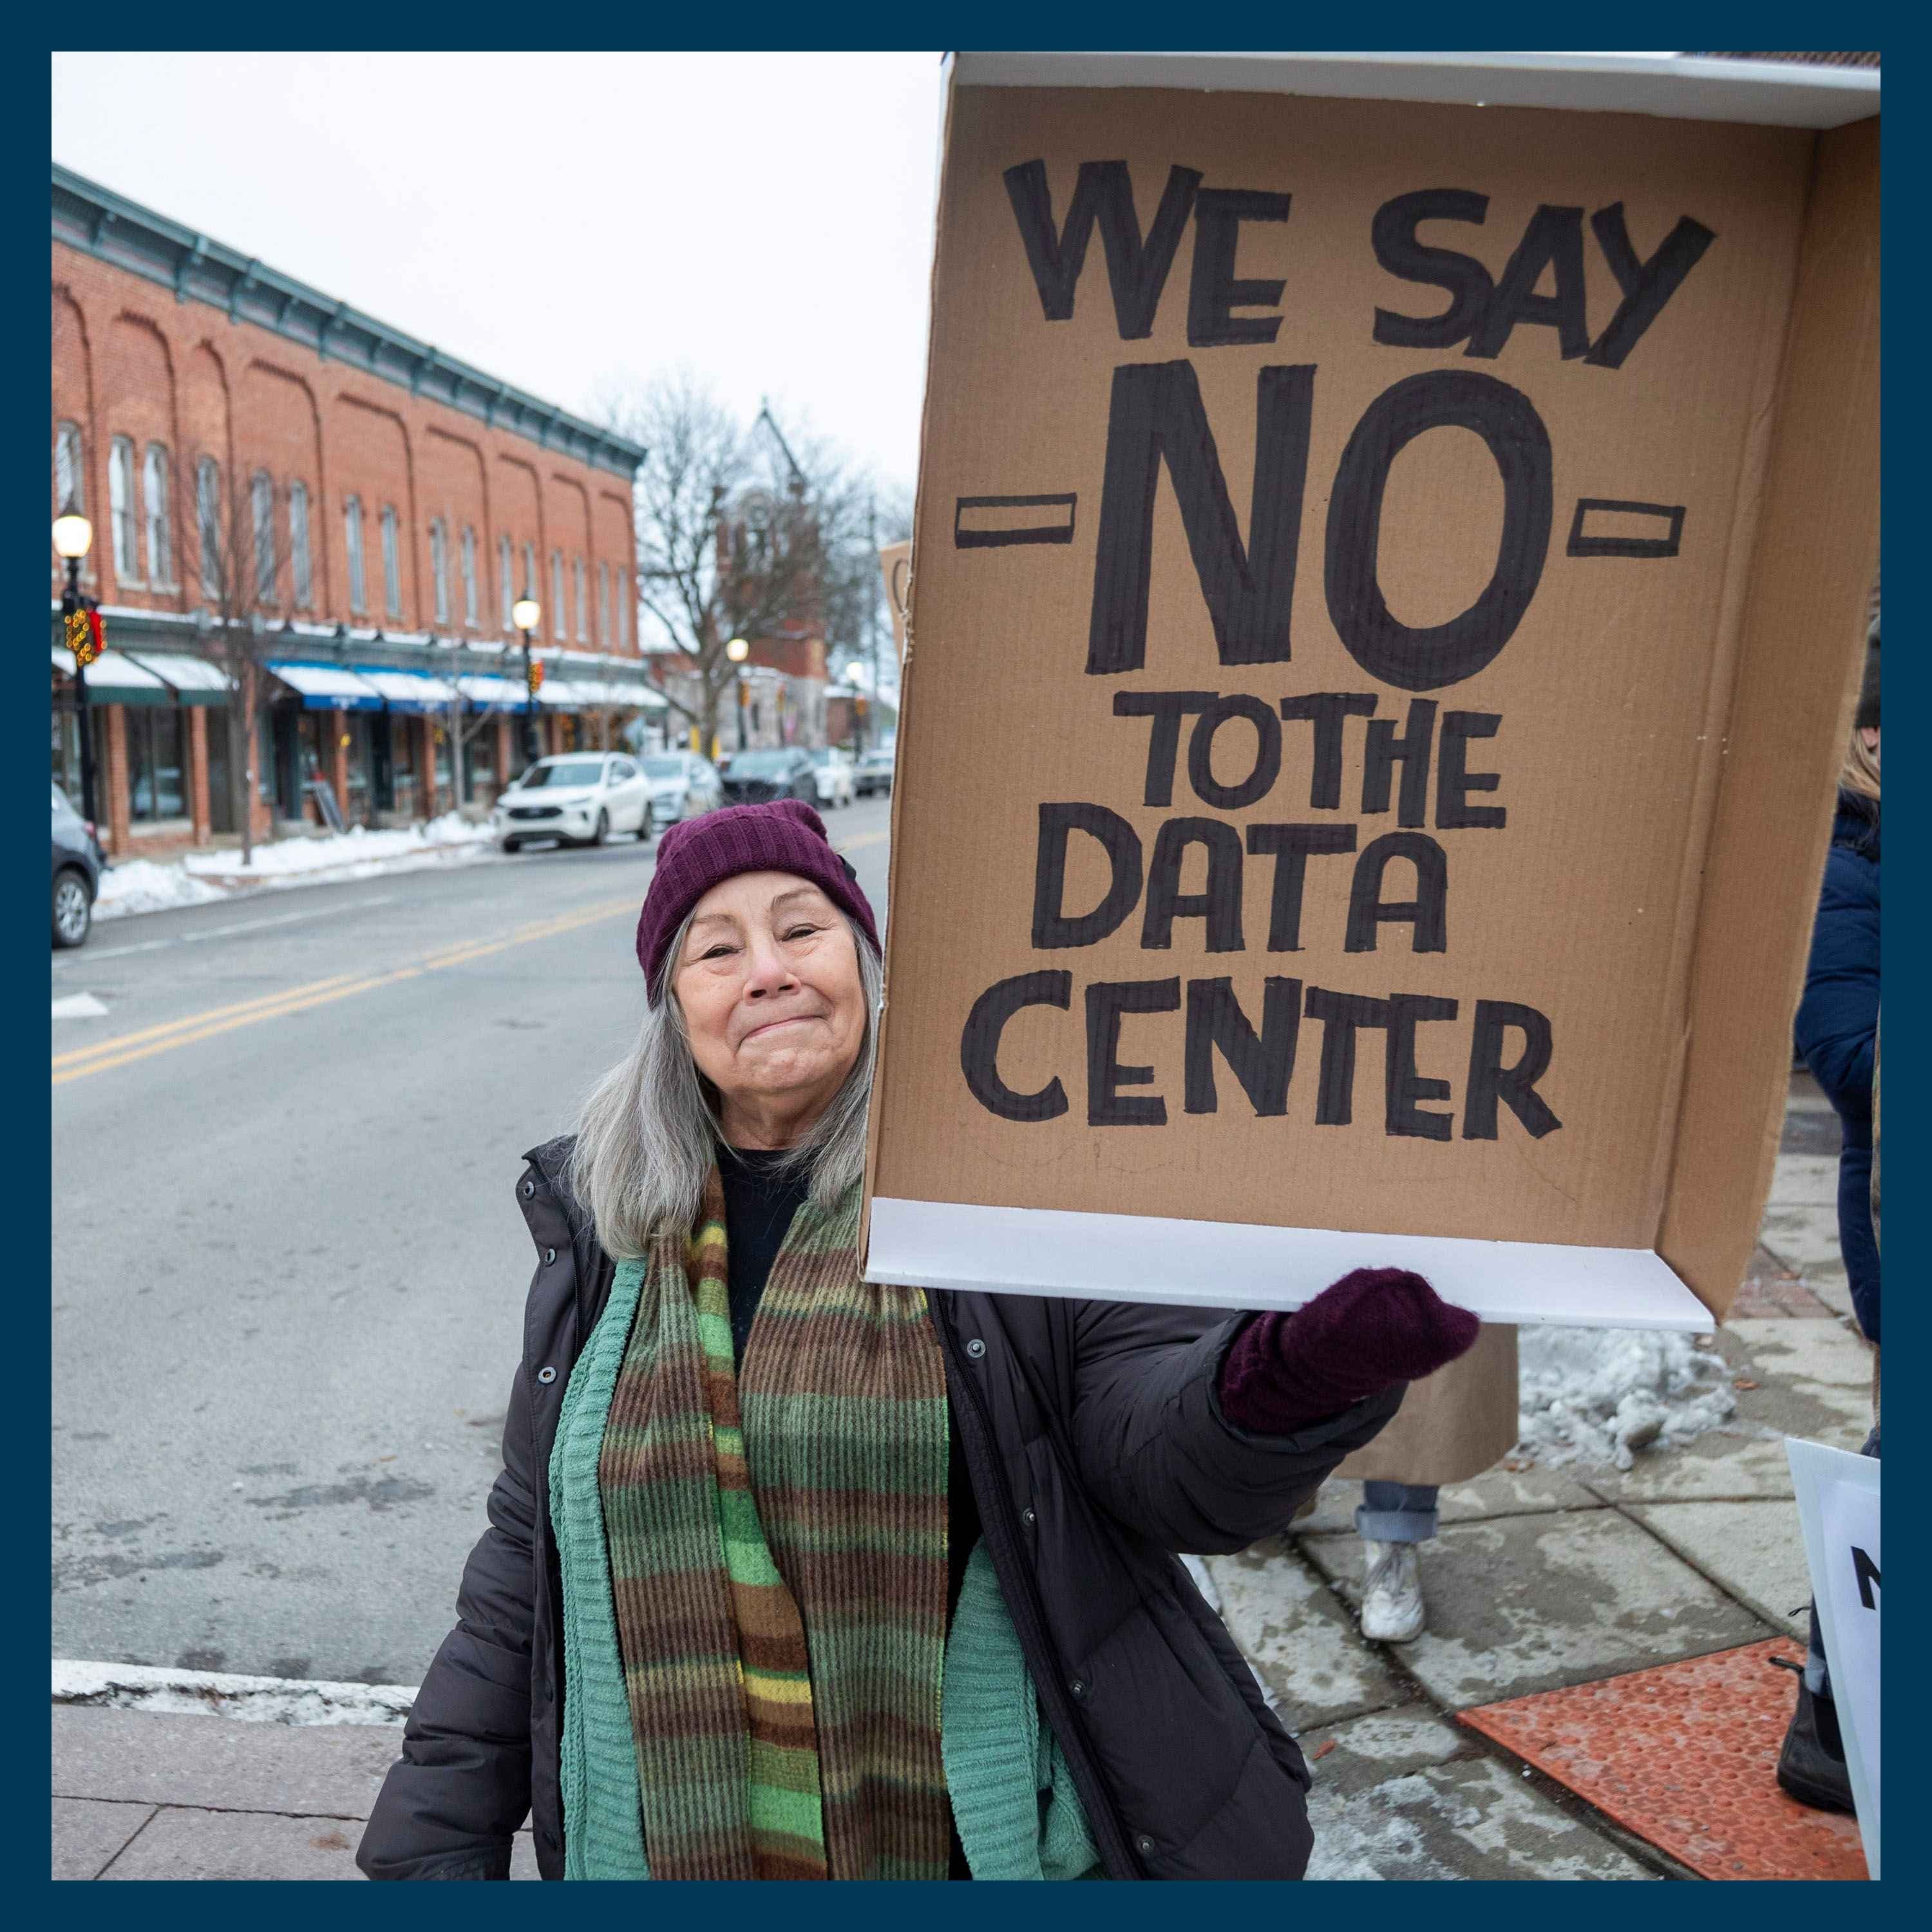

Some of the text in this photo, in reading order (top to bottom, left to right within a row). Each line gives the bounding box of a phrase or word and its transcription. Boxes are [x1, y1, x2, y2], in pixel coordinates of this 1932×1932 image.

[1003, 158, 1718, 370] WE SAY
[1113, 690, 1507, 829] TO THE
[1031, 802, 1449, 954] DATA
[960, 969, 1564, 1142] CENTER
